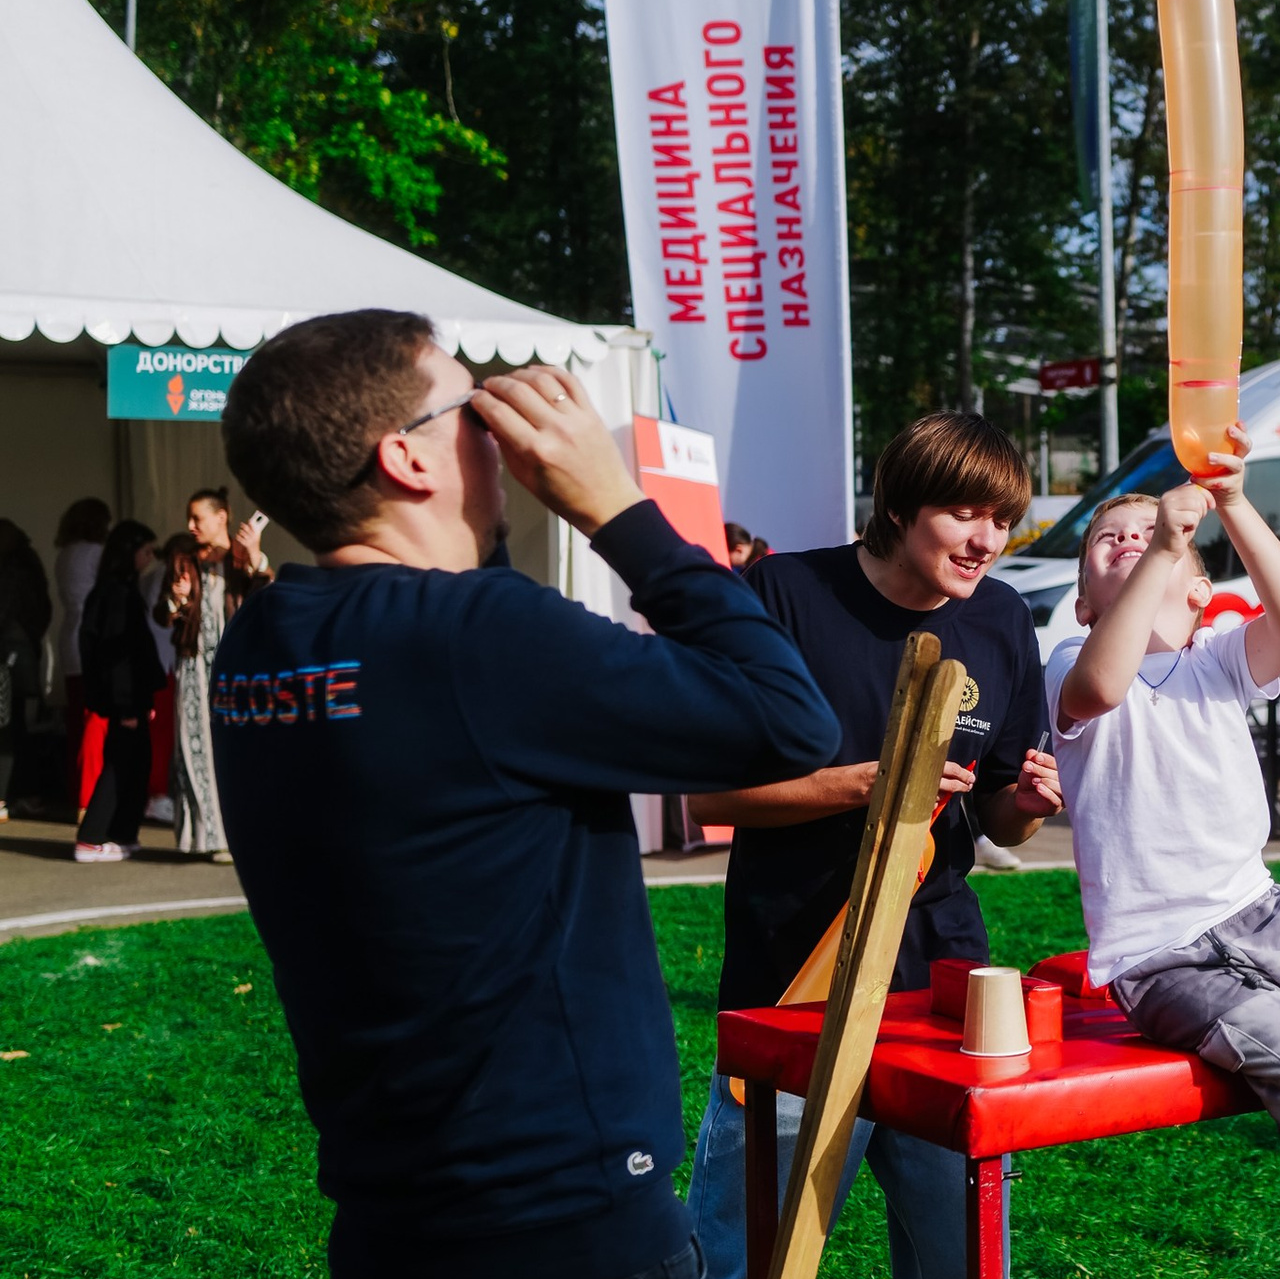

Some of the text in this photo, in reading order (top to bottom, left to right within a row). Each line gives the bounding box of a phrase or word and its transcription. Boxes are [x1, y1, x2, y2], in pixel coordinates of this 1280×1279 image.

[648, 80, 709, 323] МЕДИЦИНА
[702, 19, 768, 362] СПЕЦИАЛЬНОГО
[763, 45, 811, 328] НАЗНАЧЕНИЯ
[213, 661, 361, 725] ACOSTE
[955, 715, 991, 731] ДЕЙСТВИЕ
